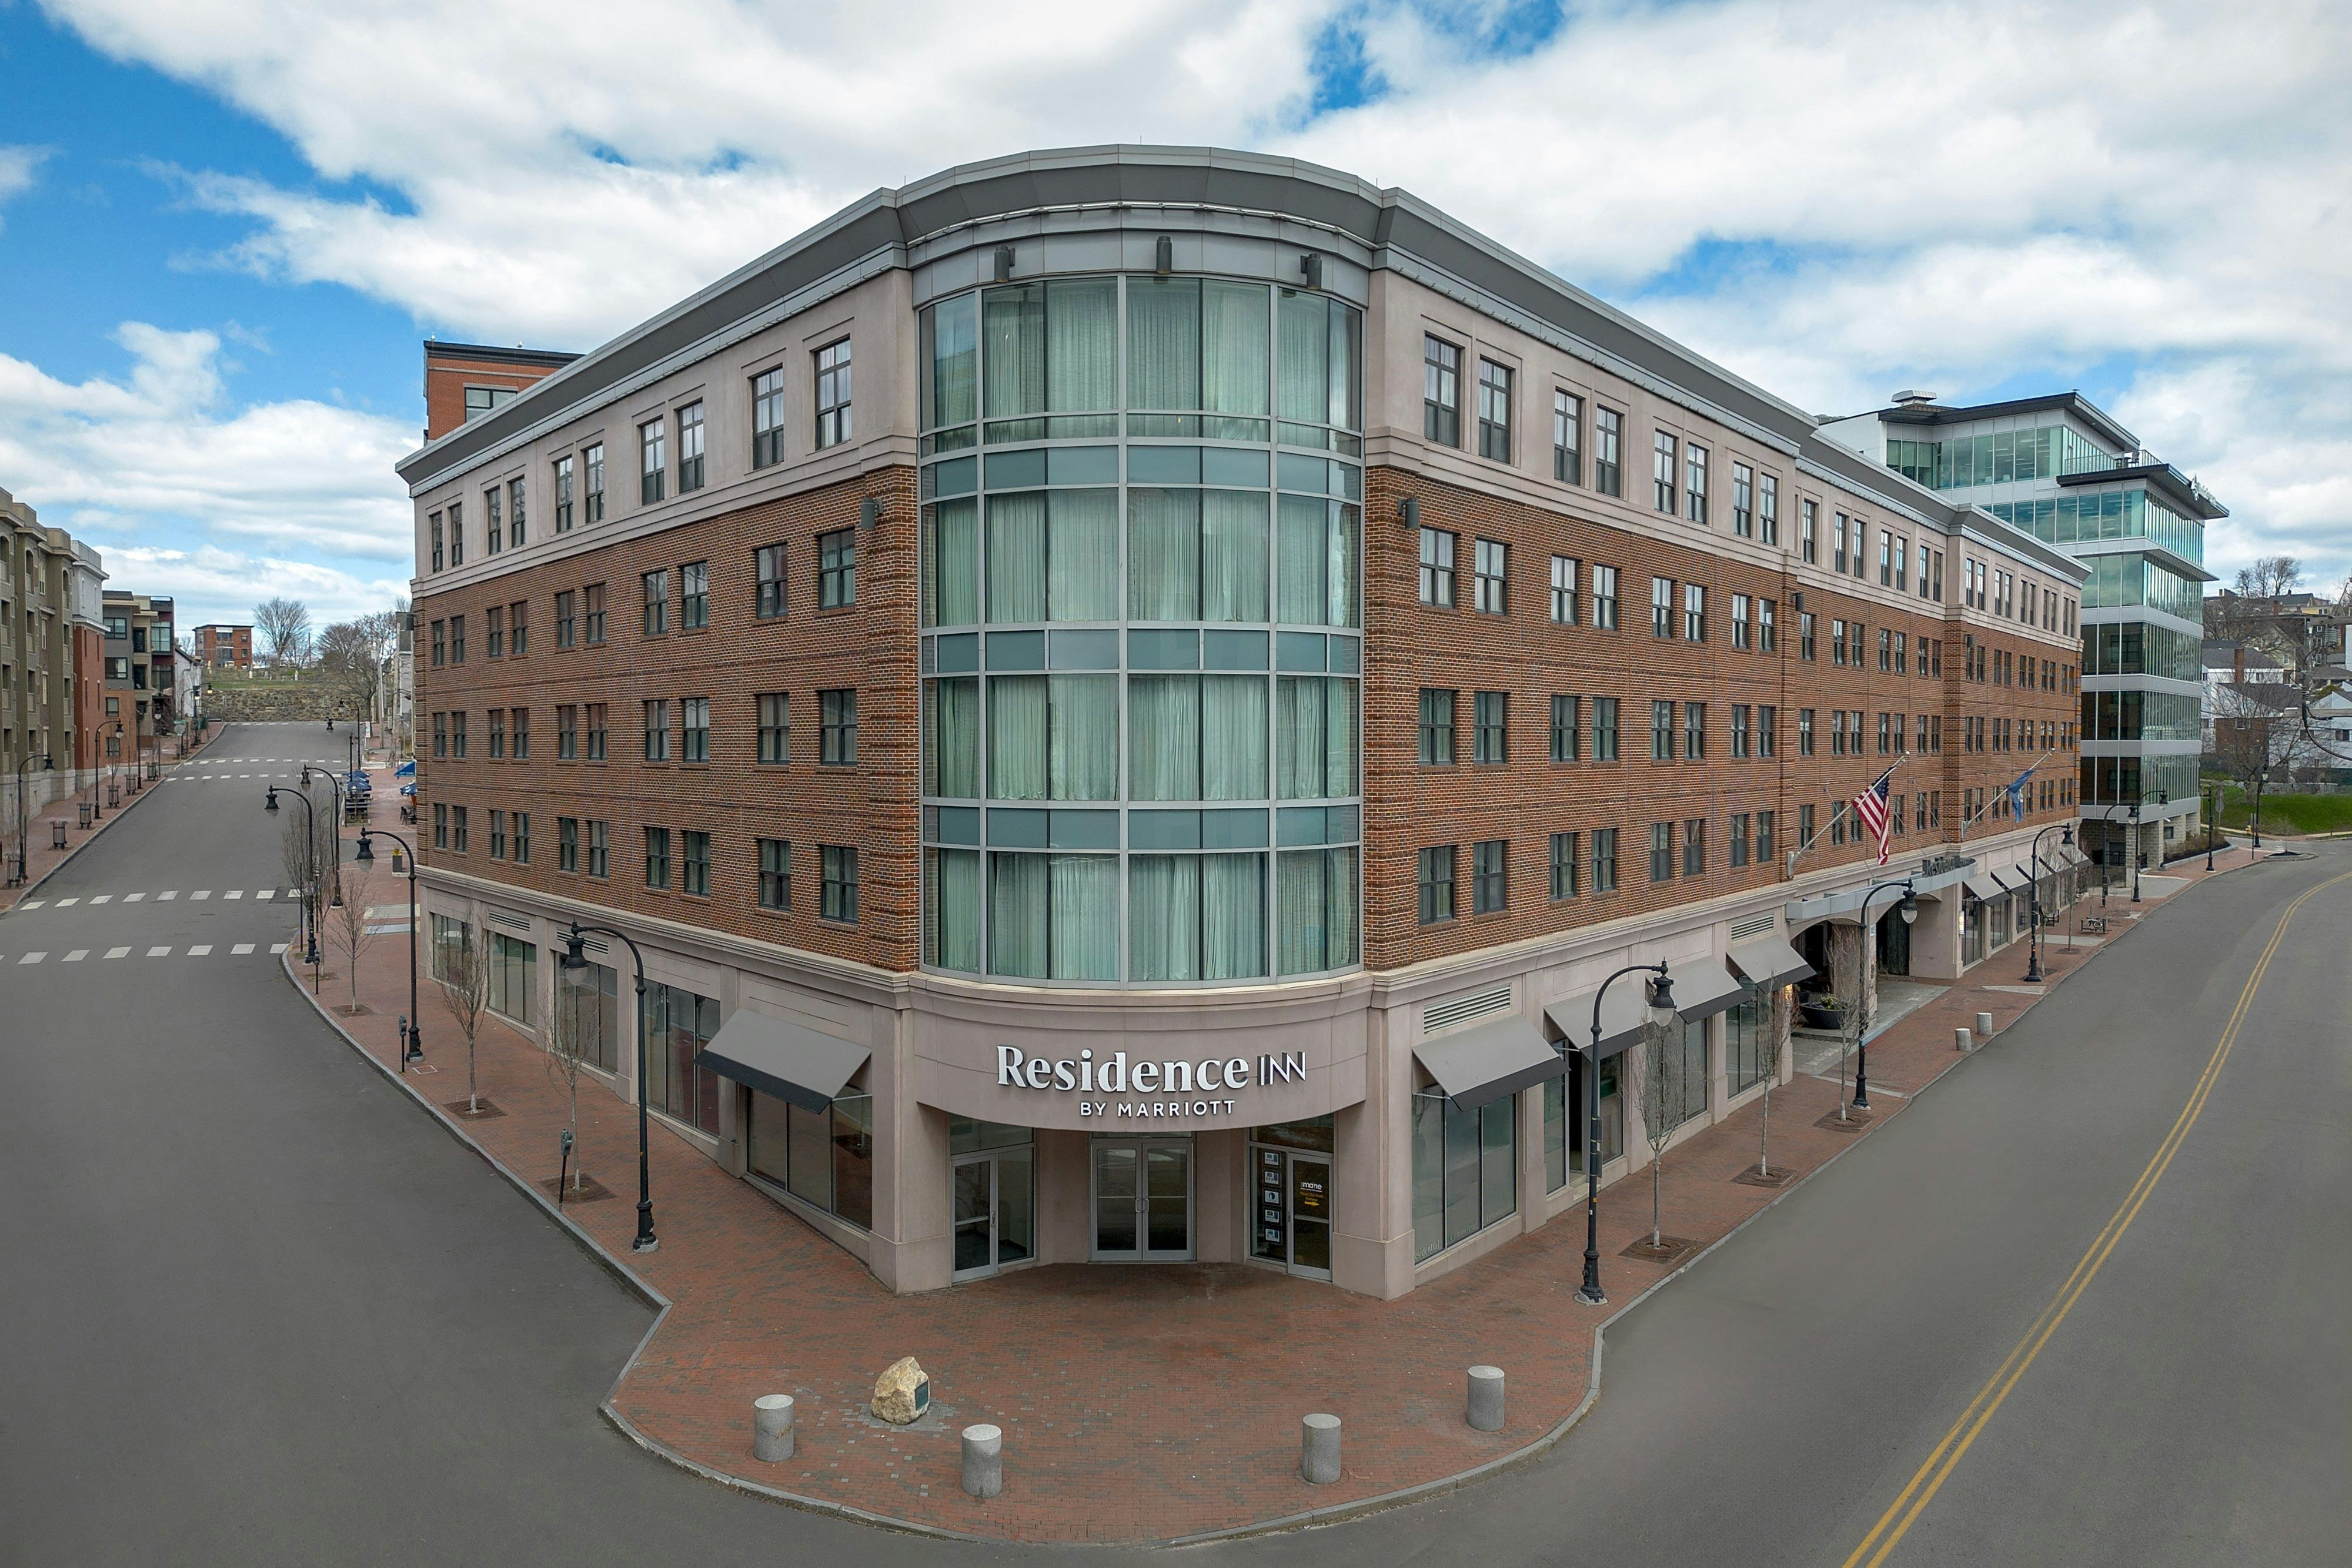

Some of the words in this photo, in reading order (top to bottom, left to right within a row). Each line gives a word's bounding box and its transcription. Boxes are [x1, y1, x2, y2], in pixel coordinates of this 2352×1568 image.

[997, 1045, 1250, 1092] Residence
[1258, 1051, 1306, 1086] INN
[1080, 1102, 1107, 1116] BY
[1117, 1100, 1235, 1117] MARRIOTT
[1415, 1239, 1439, 1259] esidential
